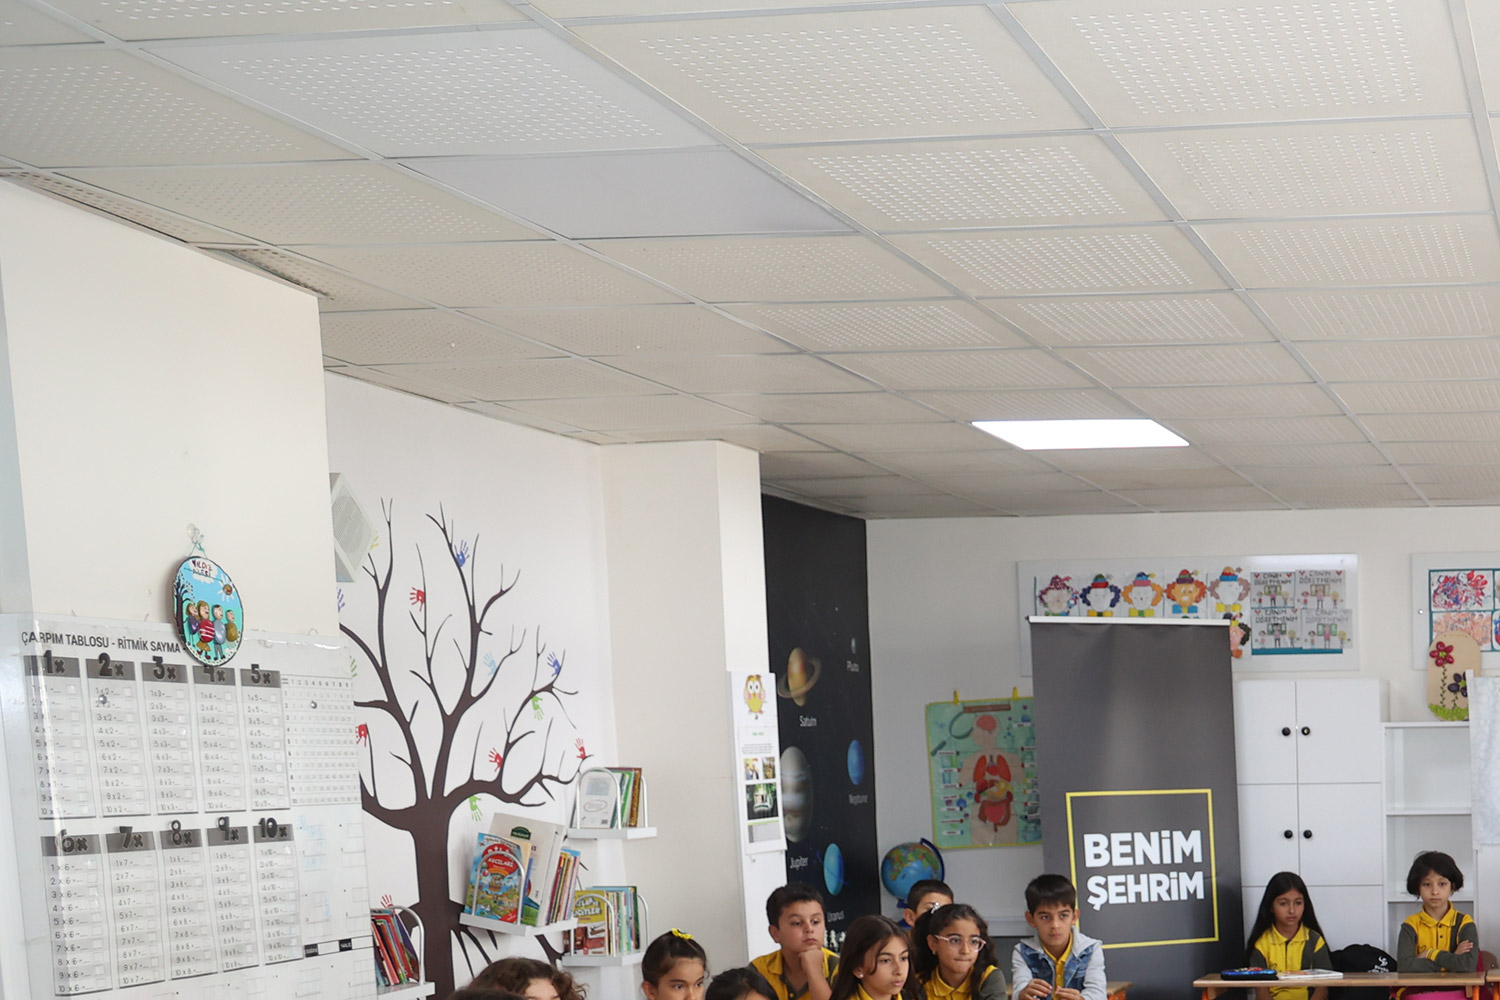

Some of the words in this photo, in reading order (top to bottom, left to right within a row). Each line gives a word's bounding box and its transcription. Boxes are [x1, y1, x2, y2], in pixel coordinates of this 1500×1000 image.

[65, 634, 110, 648] TABLOSU
[118, 636, 149, 650] RİTMİK
[150, 642, 181, 654] SAYMA
[799, 715, 817, 727] Saturn
[790, 856, 808, 870] Jupiter
